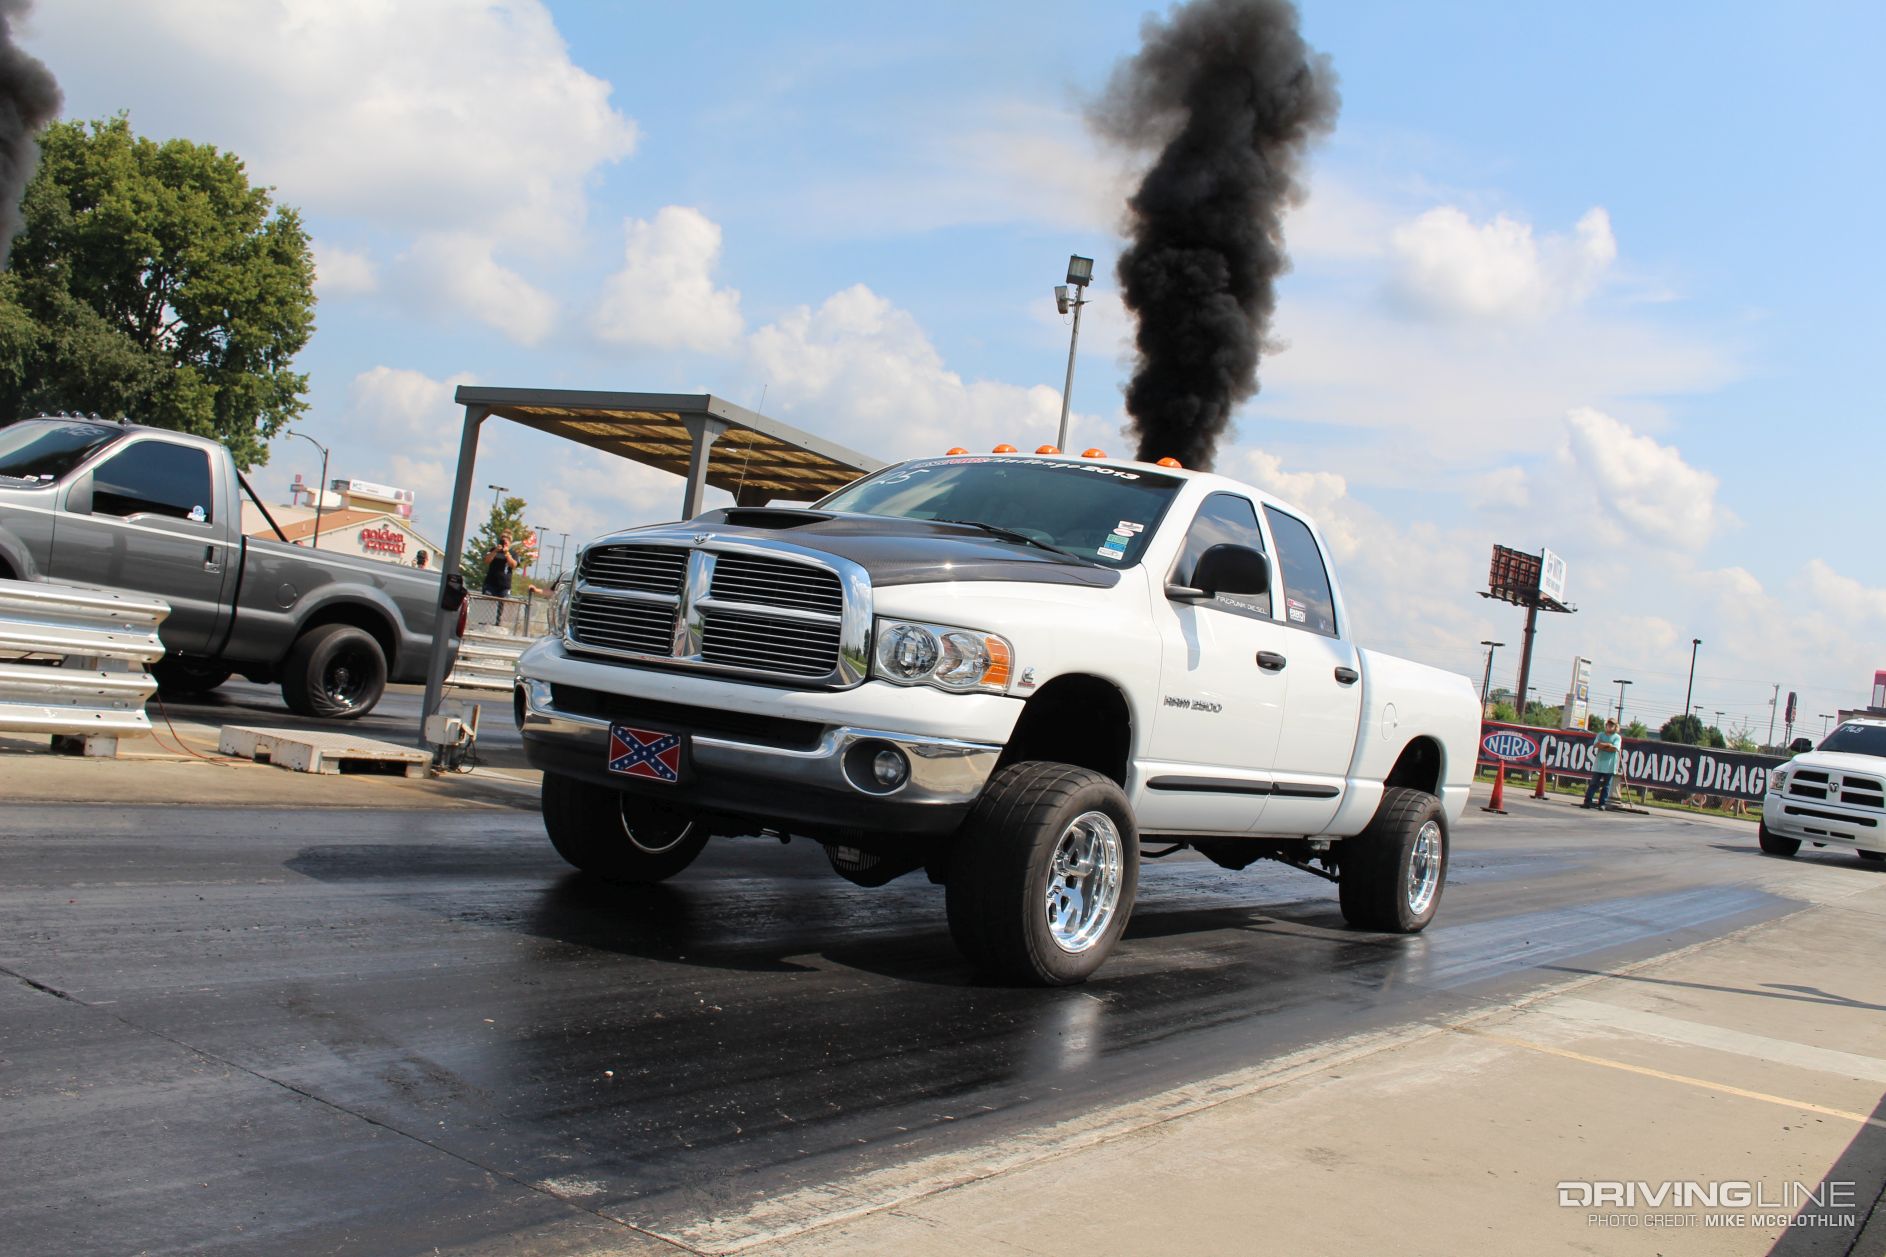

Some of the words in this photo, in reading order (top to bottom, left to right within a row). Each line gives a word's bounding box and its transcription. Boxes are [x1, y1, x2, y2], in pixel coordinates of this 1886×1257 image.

[1080, 465, 1140, 480] 2013
[361, 528, 404, 543] golden
[1488, 735, 1531, 757] NHRA
[1540, 735, 1692, 785] CROSROADS
[1696, 754, 1774, 795] DRAG
